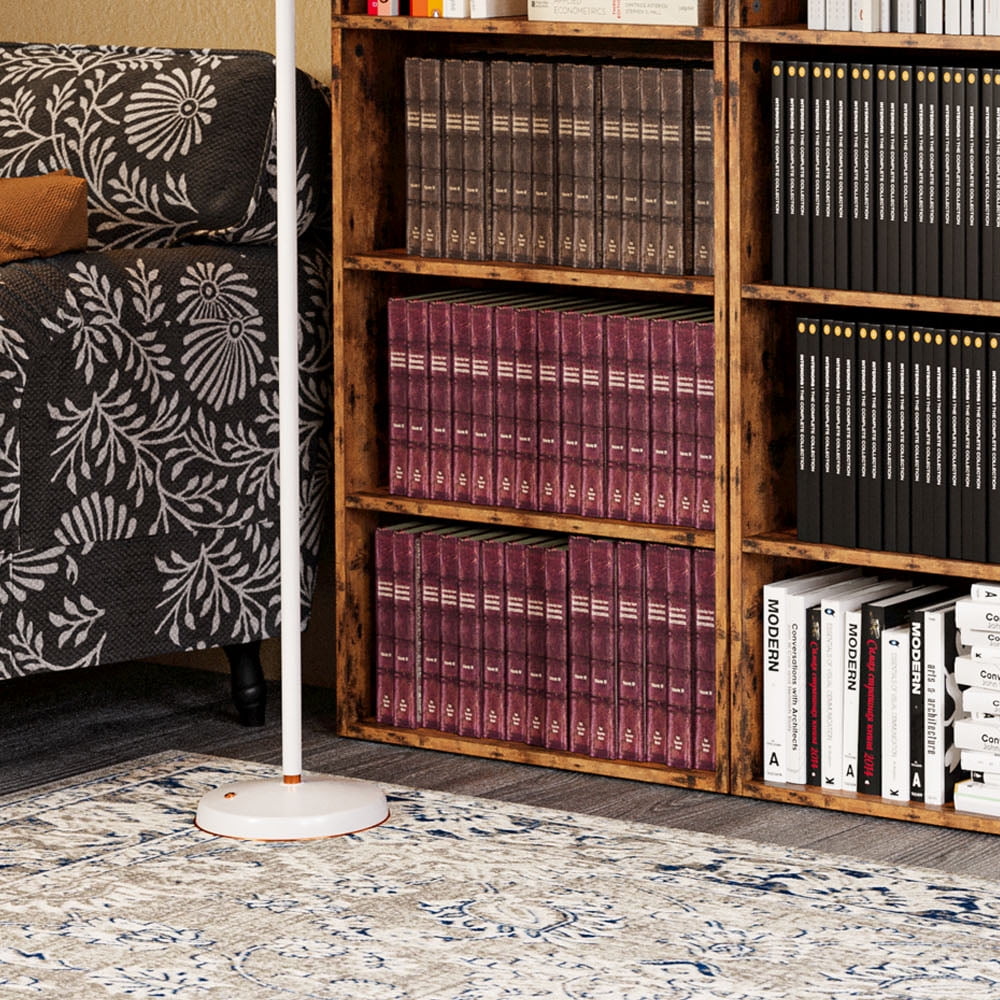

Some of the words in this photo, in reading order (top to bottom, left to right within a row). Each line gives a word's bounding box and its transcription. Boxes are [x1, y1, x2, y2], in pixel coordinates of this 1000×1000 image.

[554, 7, 606, 15] ECONOMETRICS
[768, 599, 779, 672] MODERN
[847, 623, 857, 691] MODERN
[911, 622, 921, 695] MODERN
[769, 752, 779, 767] A
[864, 752, 875, 777] 2014
[846, 764, 855, 778] A
[912, 772, 921, 788] A
